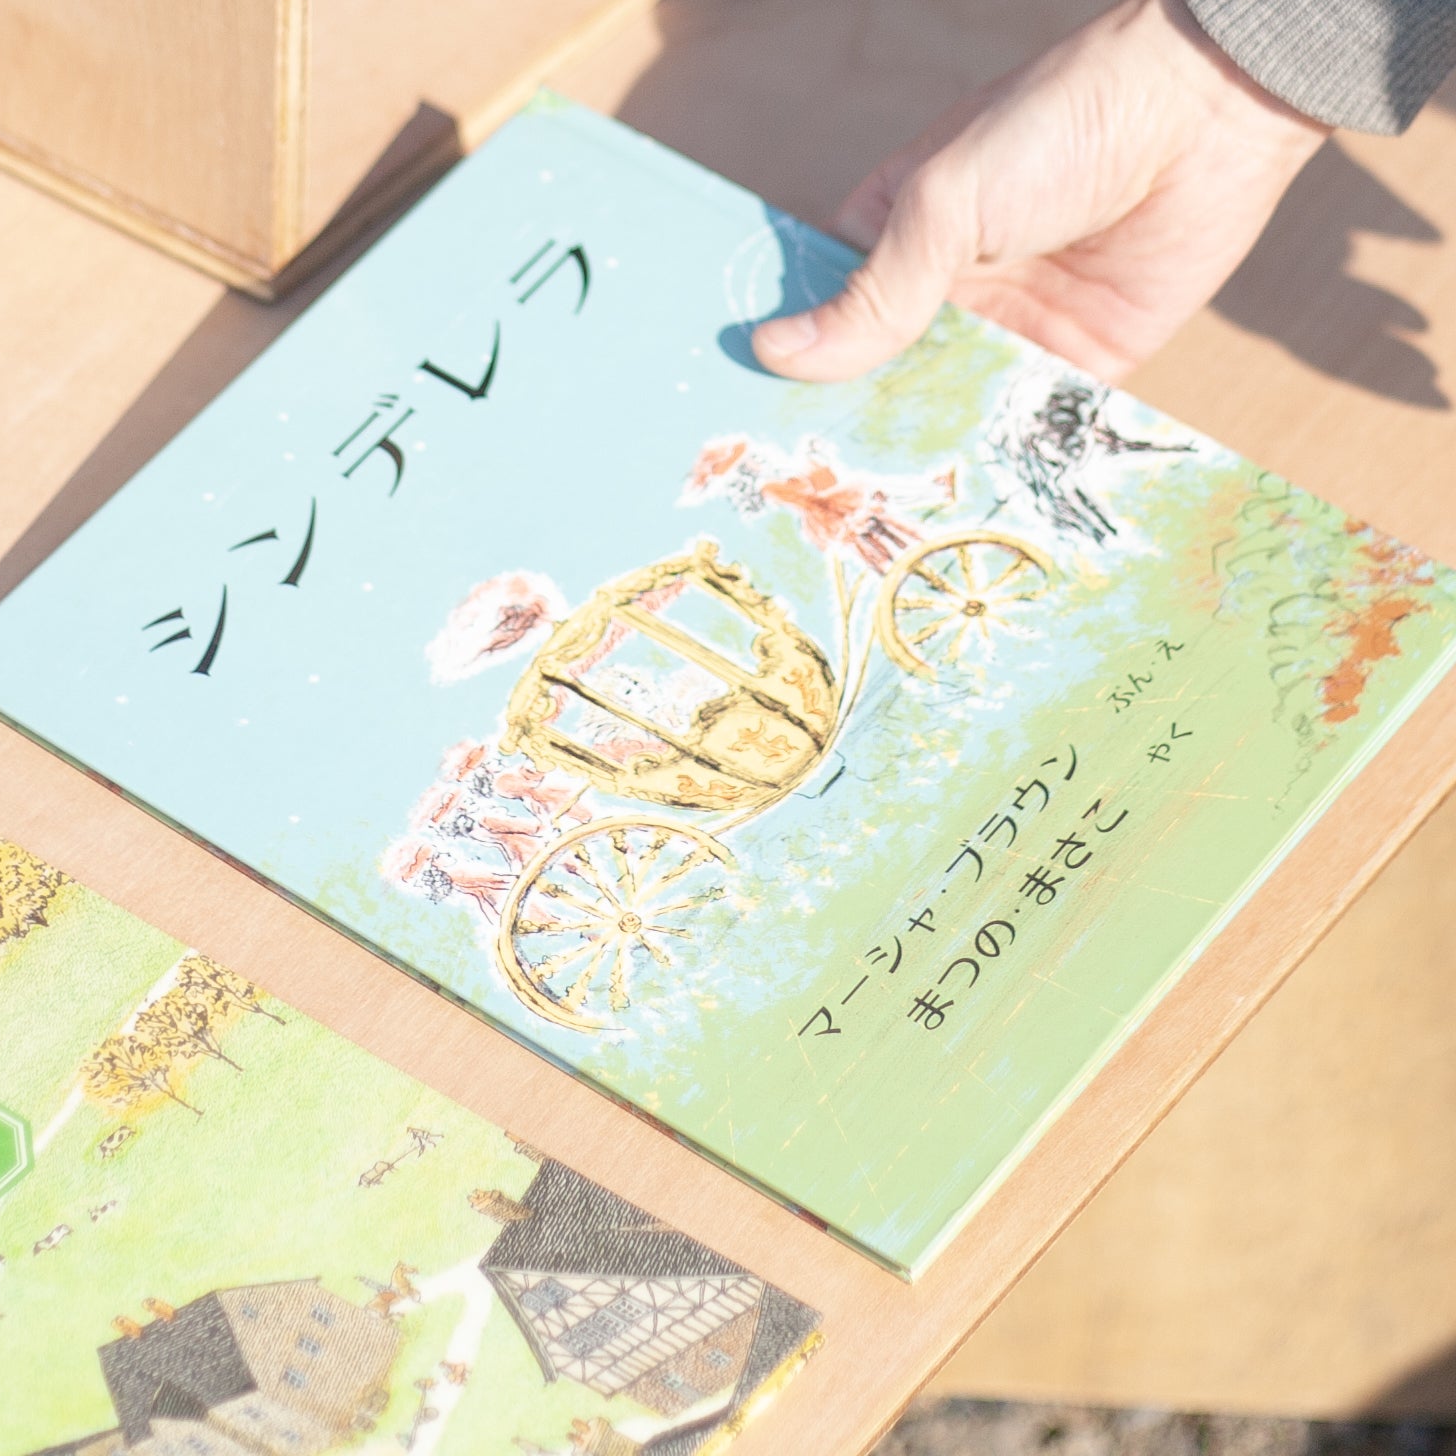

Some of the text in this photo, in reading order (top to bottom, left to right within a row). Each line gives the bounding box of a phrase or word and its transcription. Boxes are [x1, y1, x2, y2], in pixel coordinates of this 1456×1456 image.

[141, 237, 592, 677] シンデレラ
[797, 639, 1185, 1037] マーシャ・ブラウン ぶん・え
[906, 722, 1194, 1031] まつの・まさこ やく
